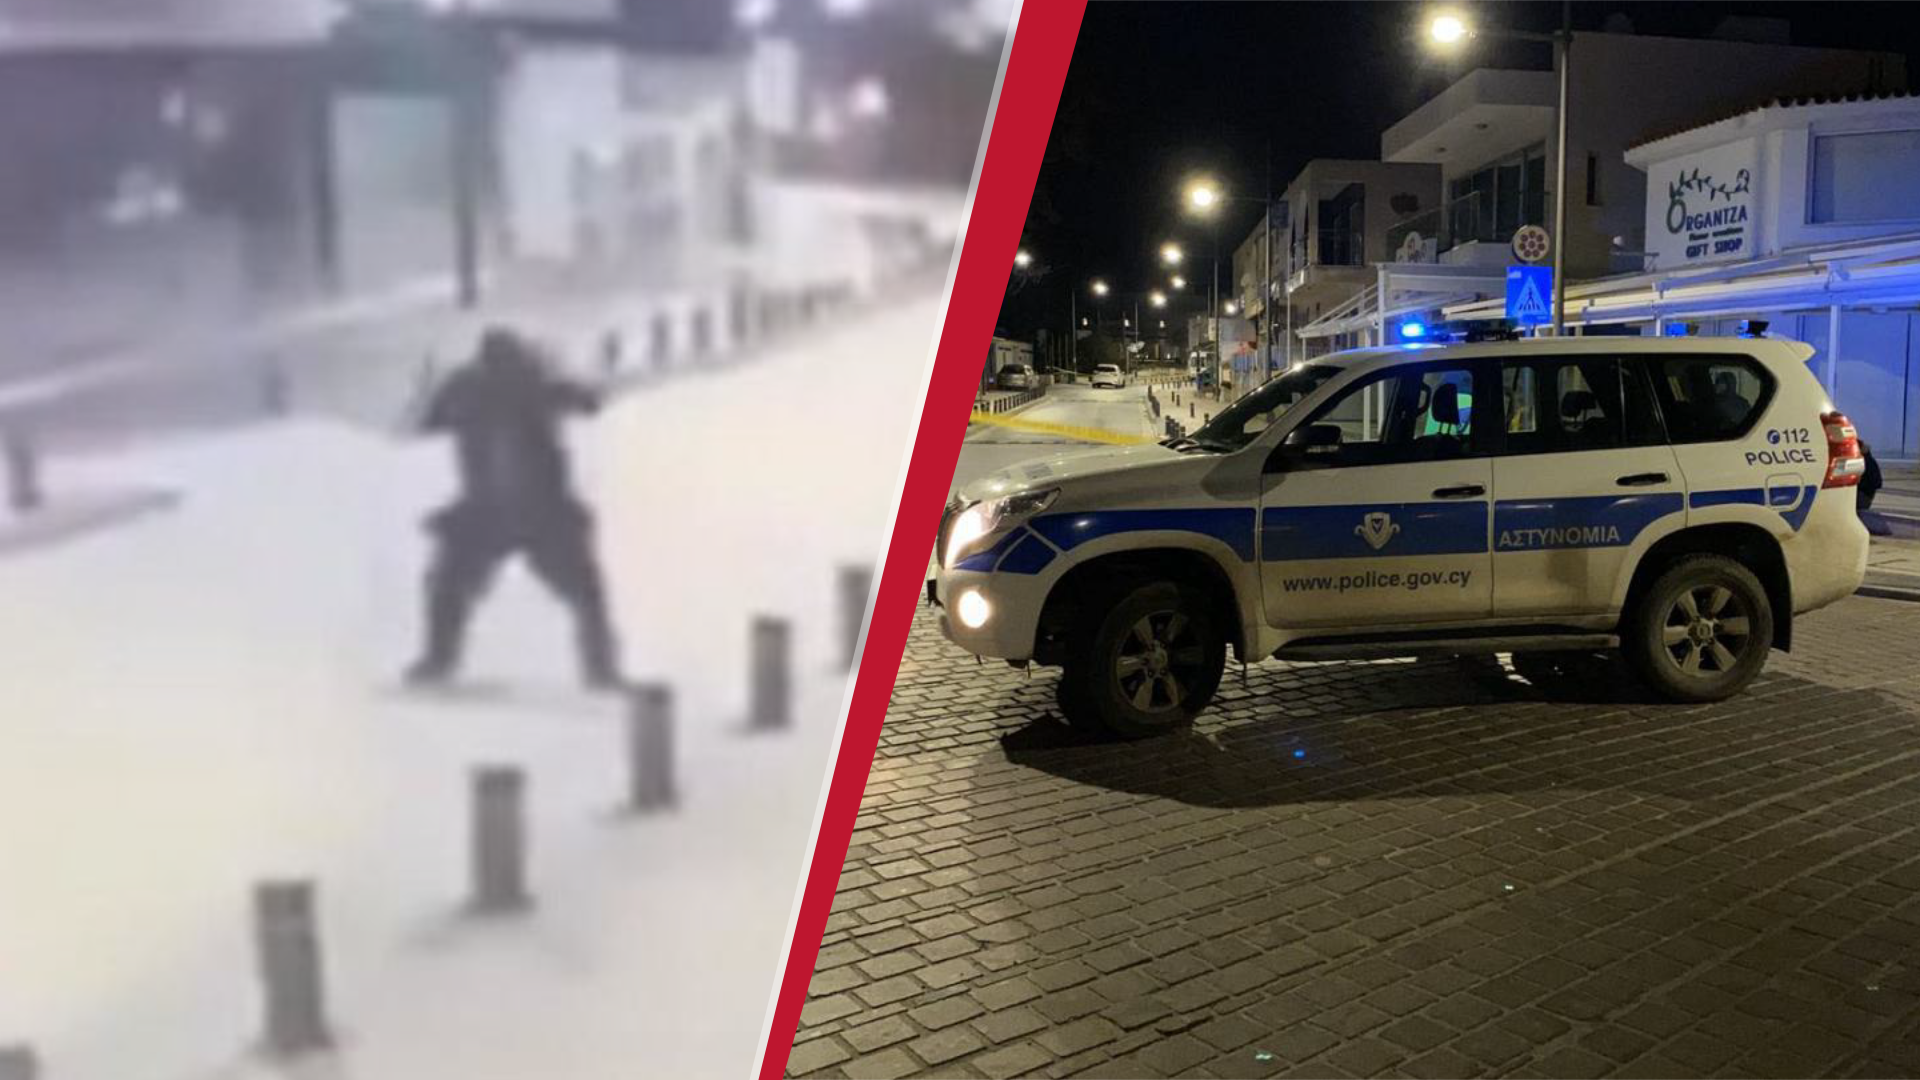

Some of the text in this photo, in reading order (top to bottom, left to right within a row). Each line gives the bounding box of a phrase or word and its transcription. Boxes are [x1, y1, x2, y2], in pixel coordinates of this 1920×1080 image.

[1666, 198, 1748, 235] ORGANTZA
[1685, 238, 1743, 258] GIFT SHOP
[1782, 428, 1810, 444] 112
[1744, 448, 1817, 466] POLICE
[1498, 525, 1621, 548] ΑΣΤΥΝΟΜΙΑ
[1283, 570, 1472, 594] www.police.gov.cy
